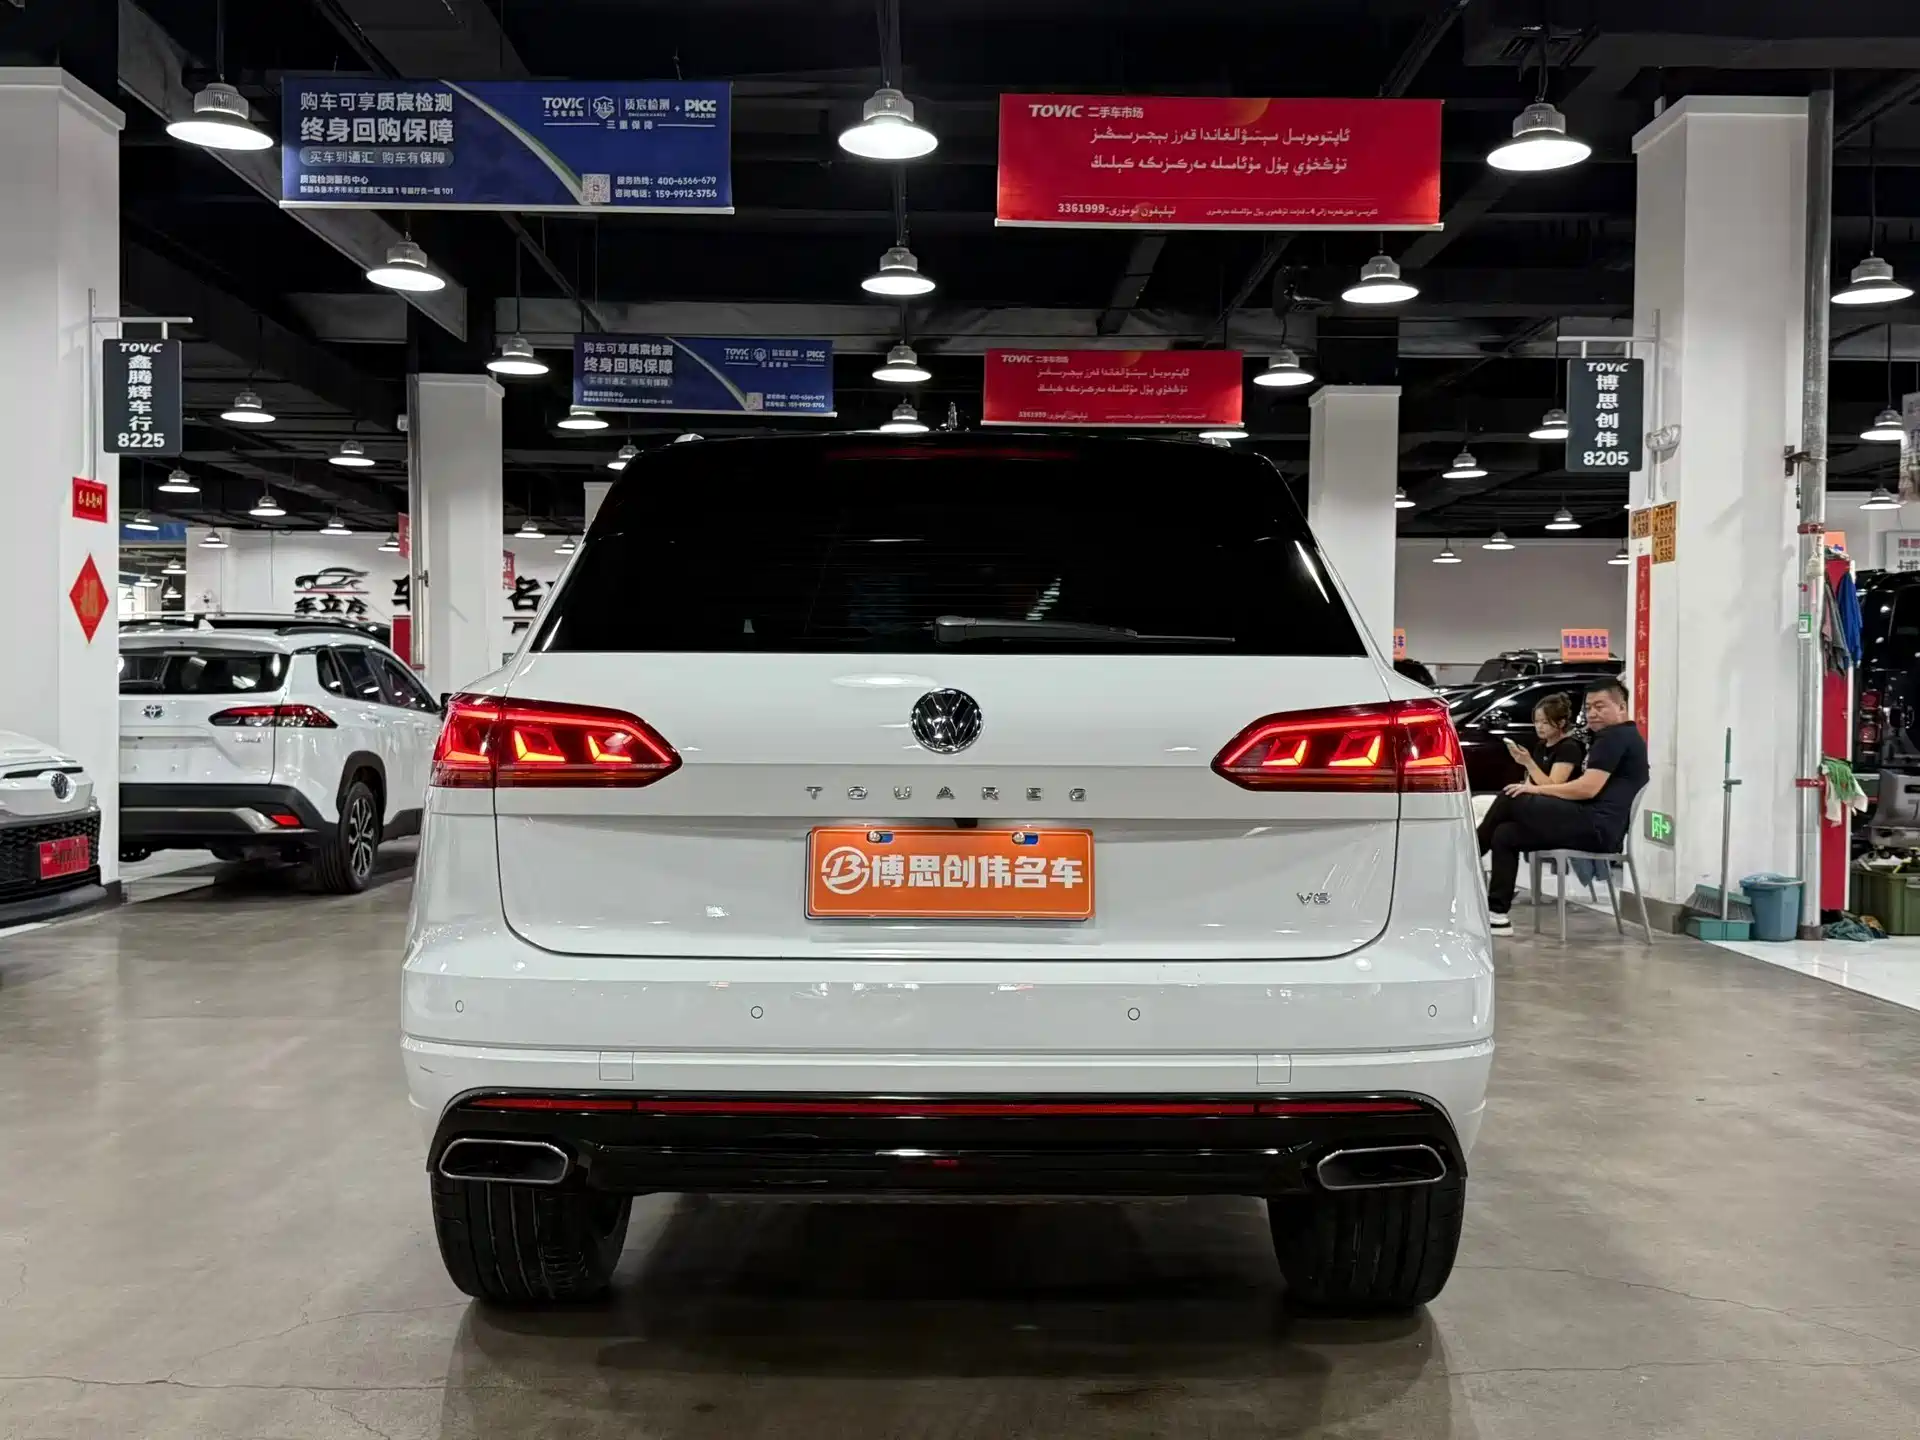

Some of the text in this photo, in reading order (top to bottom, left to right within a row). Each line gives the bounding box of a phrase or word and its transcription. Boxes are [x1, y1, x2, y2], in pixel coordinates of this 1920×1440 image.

[300, 92, 453, 113] 购车可享质宸检测
[542, 97, 585, 109] TOVIC
[685, 99, 717, 112] PICC
[1029, 104, 1144, 119] TOVIC 二手车市场
[300, 117, 454, 145] 终身回购保障
[309, 151, 446, 165] 买车到通汇 购车有保障
[655, 189, 718, 199] 159-9912-3756
[119, 342, 164, 354] TOVIC
[583, 356, 674, 374] 终身回购保障
[1001, 354, 1035, 364] TOVIC
[1586, 361, 1630, 373] TOVIC
[127, 354, 153, 432] 鑫腾辉车行
[1595, 374, 1620, 449] 博思创伟
[117, 433, 166, 449] 8225
[1583, 451, 1630, 467] 8205
[804, 785, 1087, 802] TOUAREG
[871, 854, 1084, 889] 博思创伟名车
